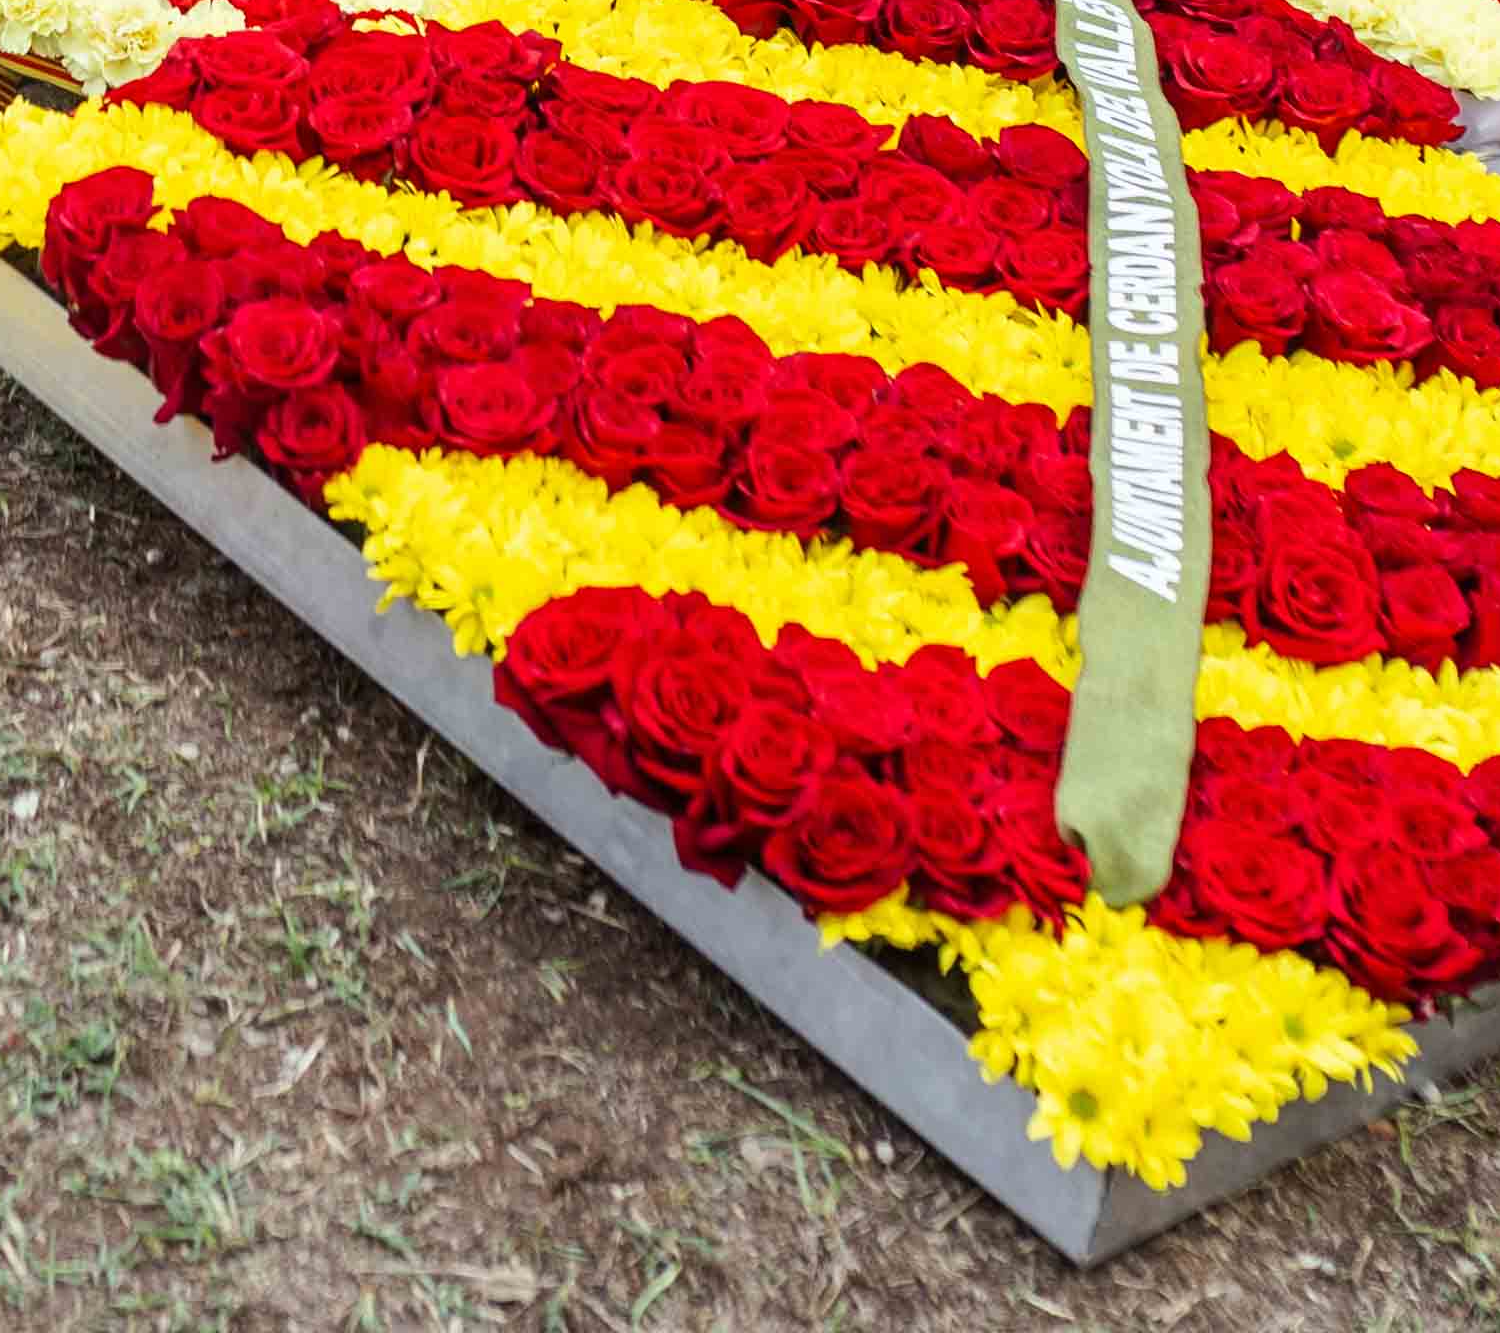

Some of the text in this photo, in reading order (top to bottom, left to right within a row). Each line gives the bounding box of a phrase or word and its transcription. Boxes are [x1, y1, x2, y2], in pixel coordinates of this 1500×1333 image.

[1090, 83, 1157, 137] DEL
[1092, 135, 1179, 336] CERDANYOLA
[1107, 341, 1181, 387] DE
[1105, 385, 1185, 603] AJUNTAMENT
